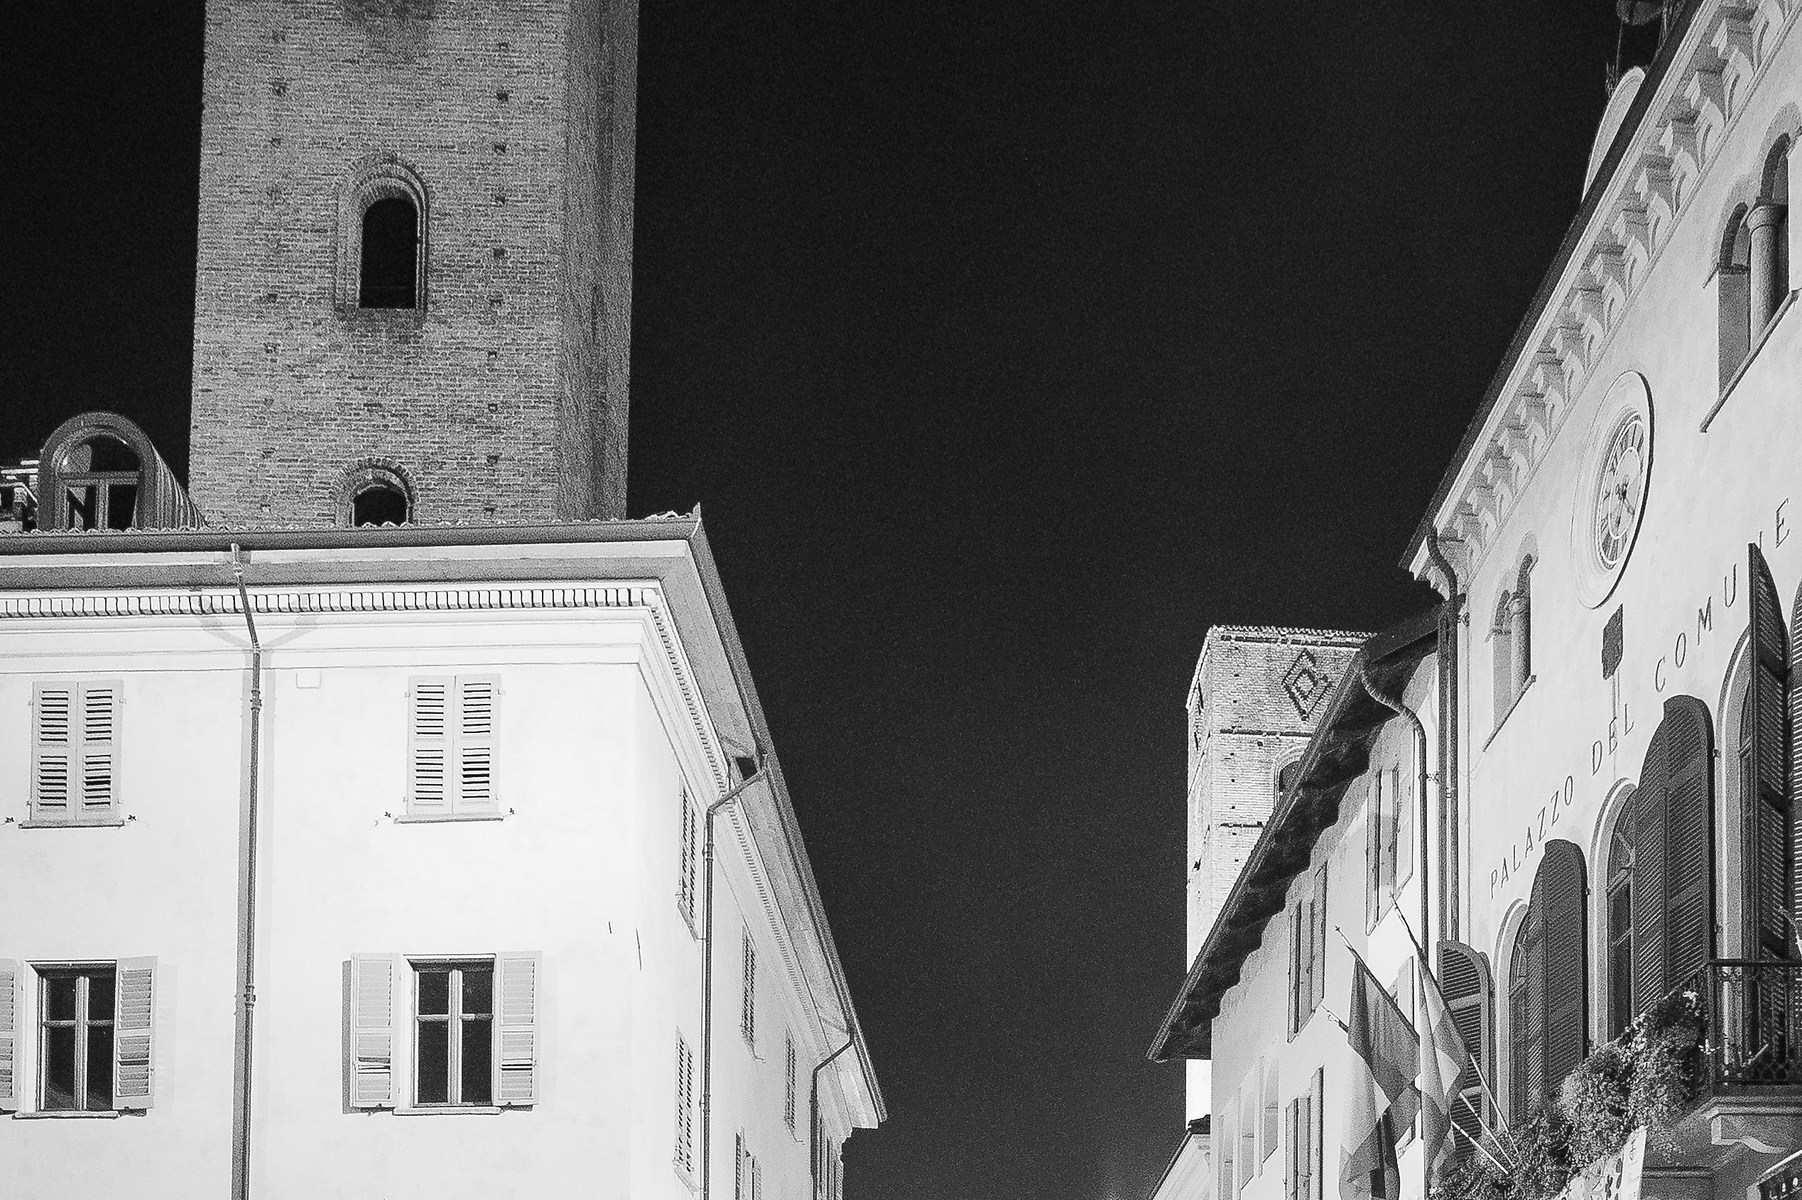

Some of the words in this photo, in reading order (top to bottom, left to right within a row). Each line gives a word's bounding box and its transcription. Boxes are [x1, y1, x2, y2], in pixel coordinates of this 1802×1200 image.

[1490, 775, 1574, 900] PALAZZO
[1592, 703, 1635, 776] DEL
[1655, 497, 1791, 693] COMUE
